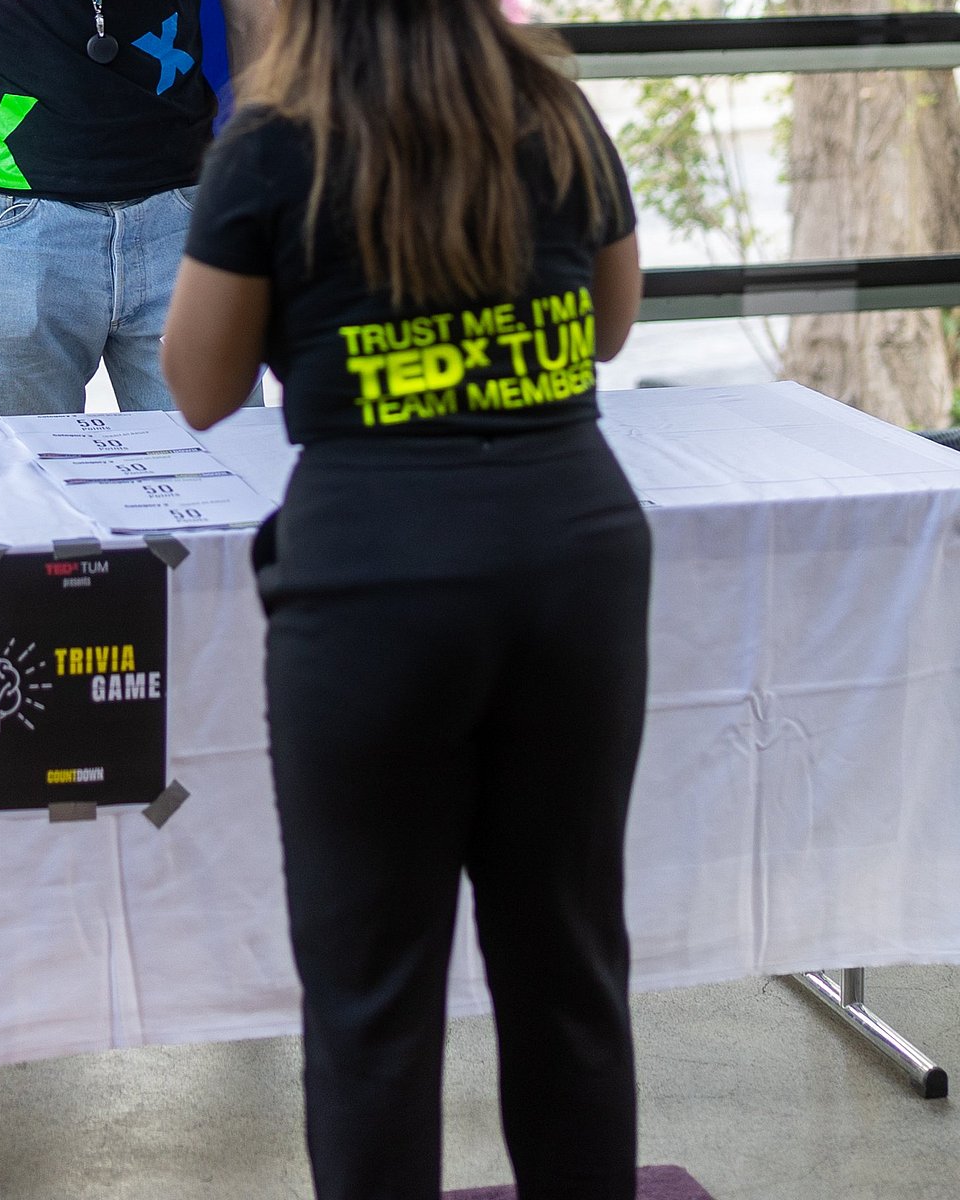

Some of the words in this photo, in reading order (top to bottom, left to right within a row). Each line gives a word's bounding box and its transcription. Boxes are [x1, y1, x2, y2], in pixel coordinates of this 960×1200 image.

[339, 313, 454, 355] TRUST
[532, 290, 578, 327] I'M
[355, 388, 457, 426] TEAM
[76, 418, 105, 427] 50
[93, 439, 122, 447] 50
[116, 463, 148, 472] 50
[142, 484, 174, 494] 50
[169, 509, 202, 519] 50
[54, 644, 136, 676] TRIVIA
[91, 671, 161, 702] GAME
[47, 767, 104, 784] COUNTDOWN
